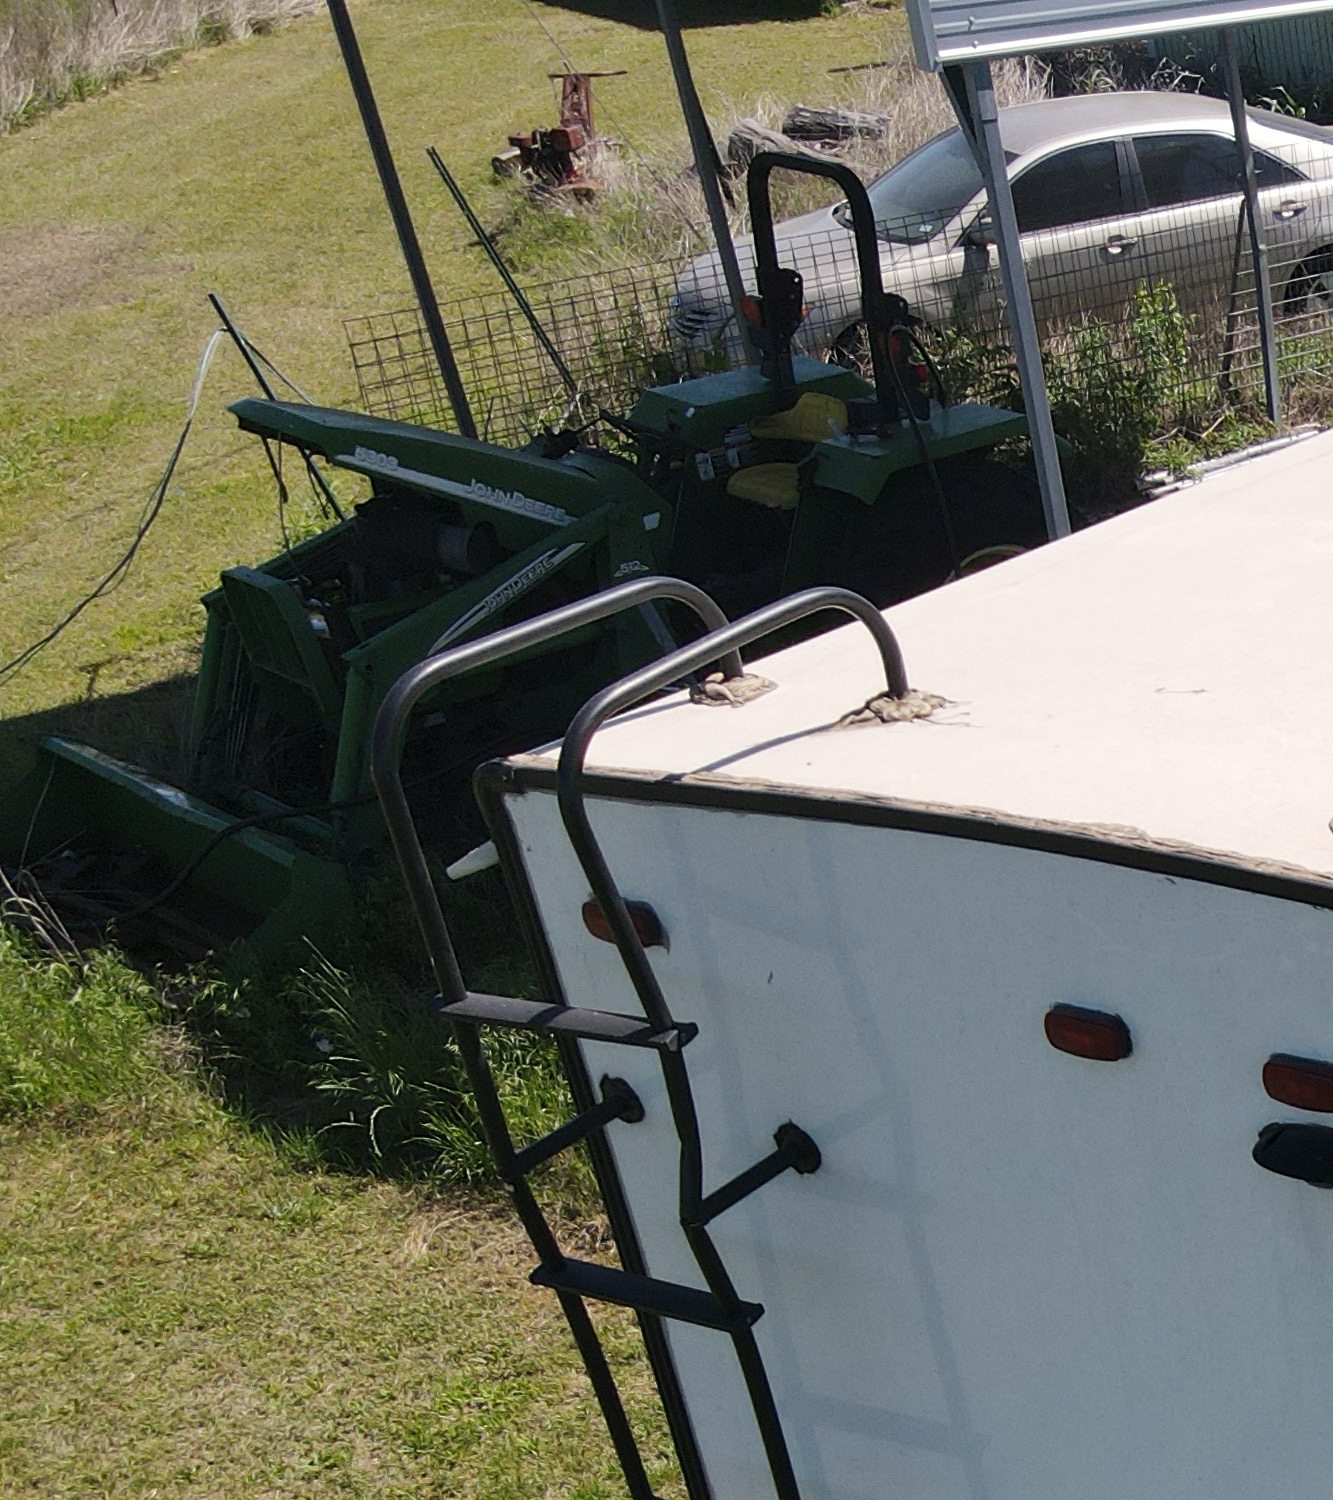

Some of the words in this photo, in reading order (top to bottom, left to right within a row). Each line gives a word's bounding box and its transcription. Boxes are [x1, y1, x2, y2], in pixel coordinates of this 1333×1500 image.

[465, 478, 511, 506] JOHN
[512, 491, 566, 522] DEERE
[512, 557, 555, 595] DEERE
